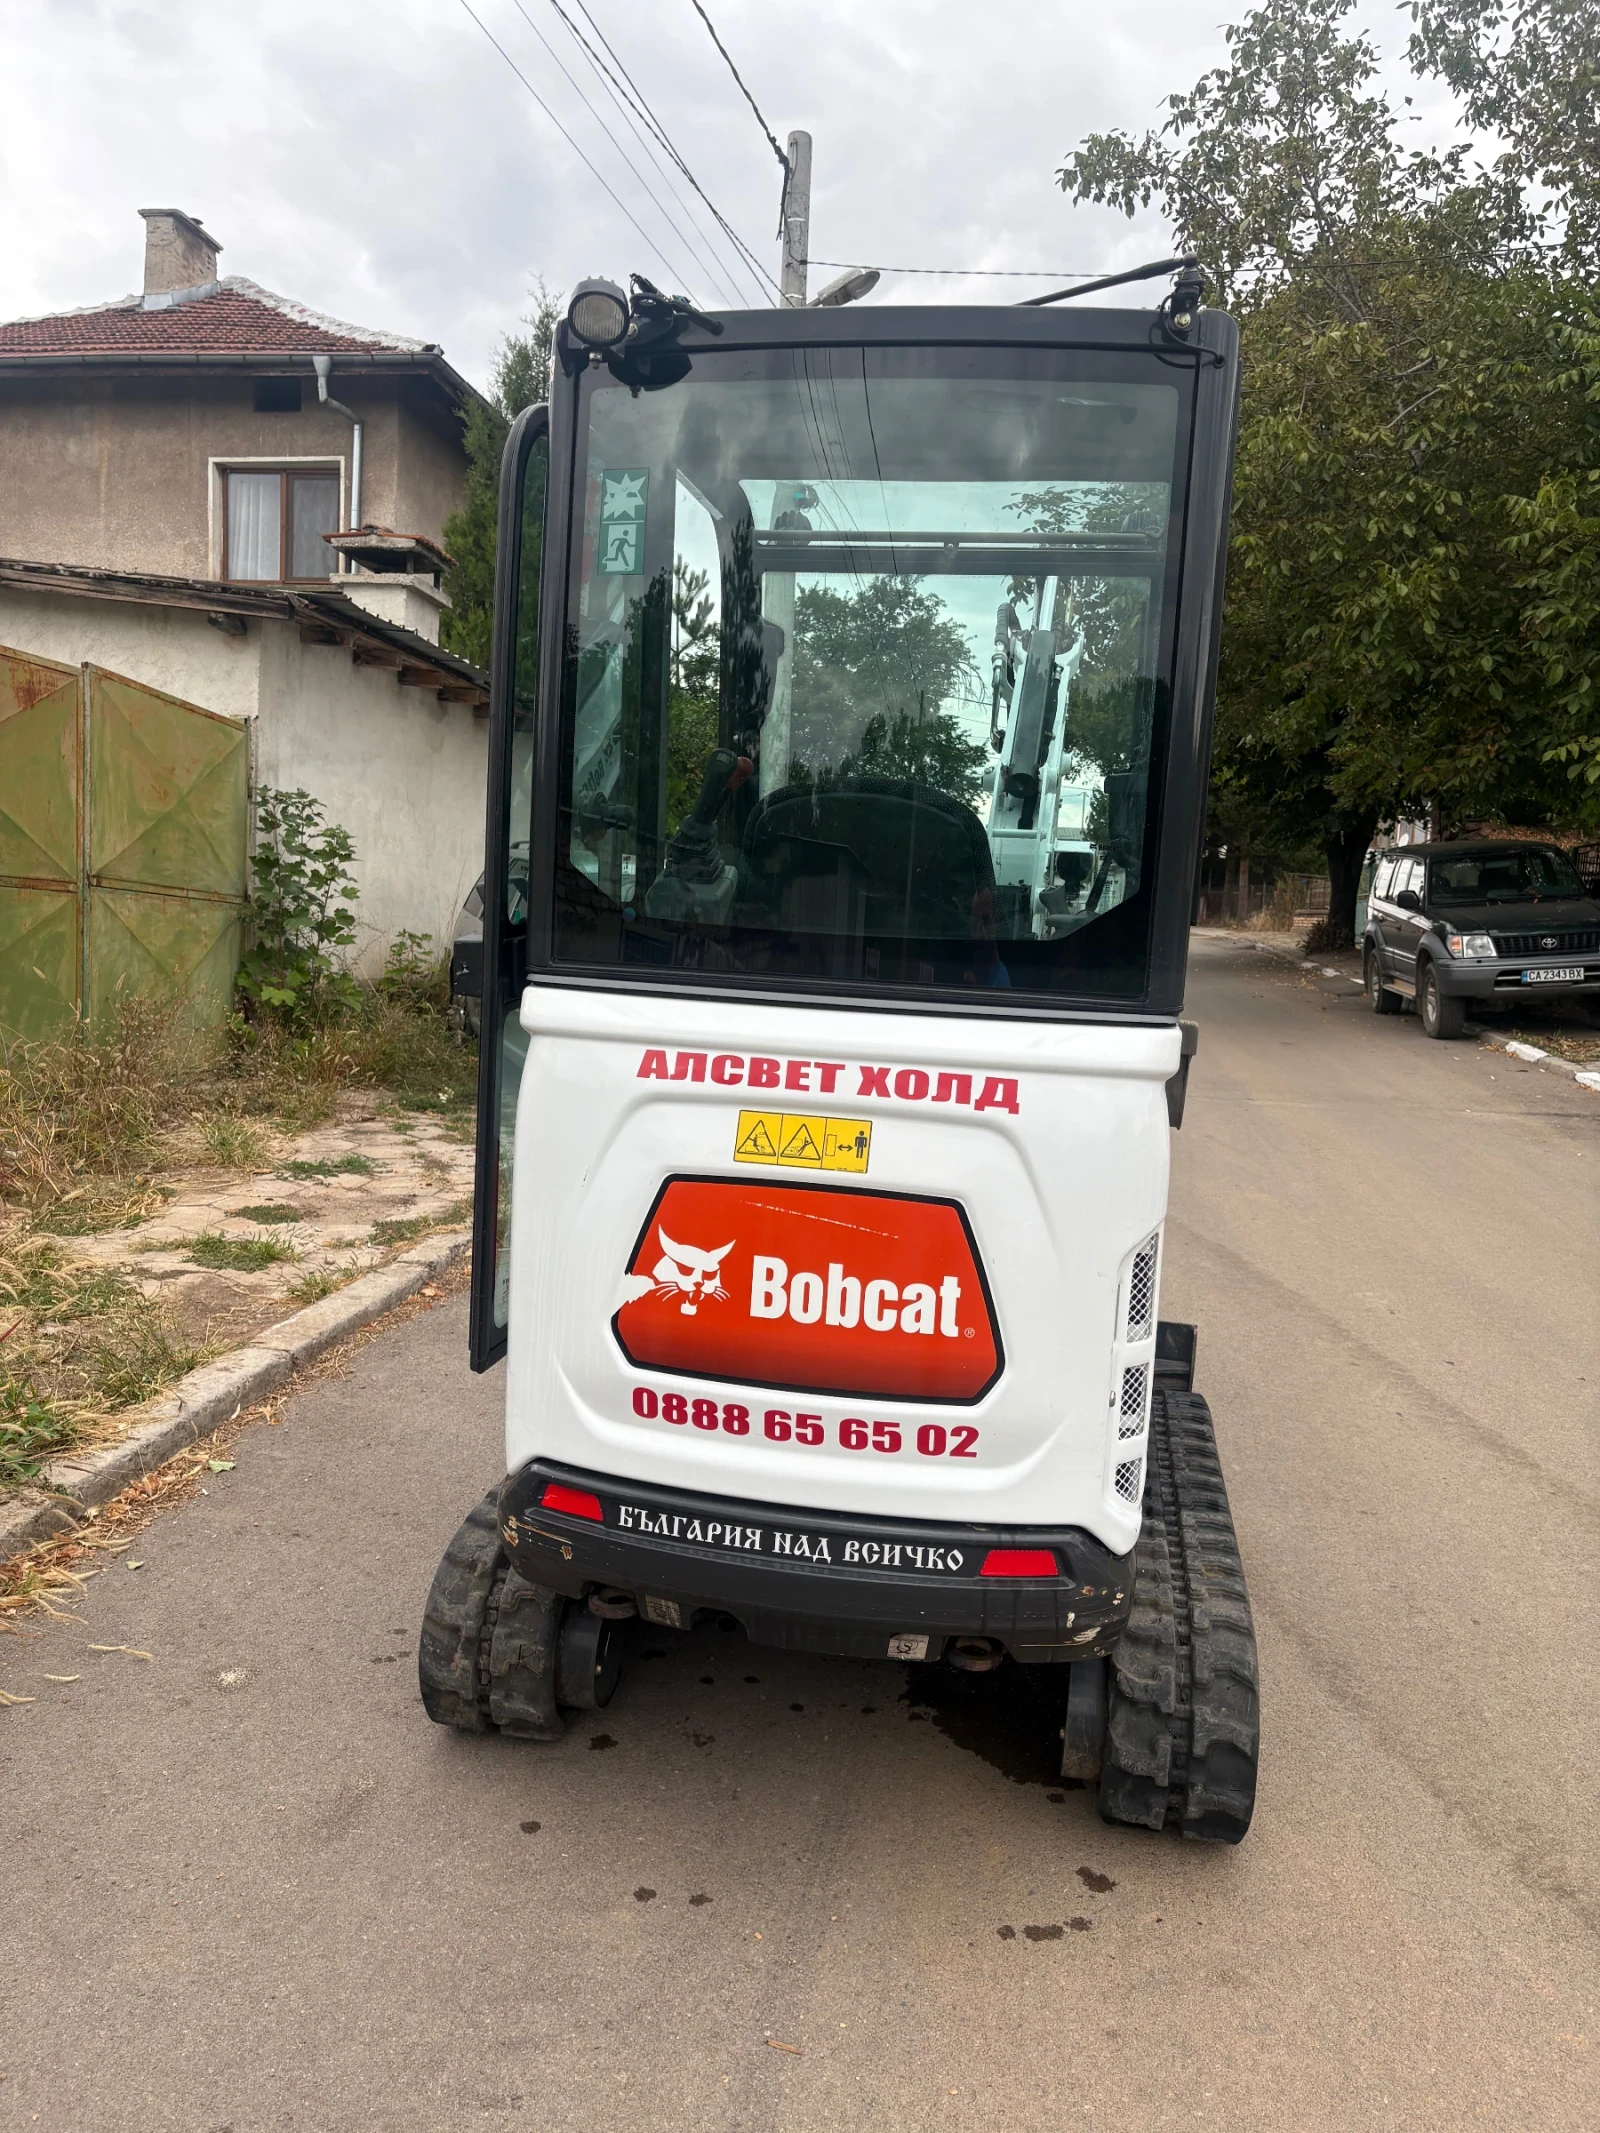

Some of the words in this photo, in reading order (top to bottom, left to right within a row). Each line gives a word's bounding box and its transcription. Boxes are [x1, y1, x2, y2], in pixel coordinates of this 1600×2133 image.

[1543, 969, 1567, 980] 2343
[637, 1050, 845, 1093] АЛСВЕТ
[858, 1066, 1019, 1114] ХОЛД
[750, 1256, 961, 1337] Bobcat
[632, 1387, 749, 1435] 0888
[764, 1410, 824, 1446] 65
[839, 1418, 902, 1453] 65
[917, 1424, 978, 1458] 02
[618, 1505, 762, 1551] БЪЛГАРИЯ
[773, 1532, 832, 1564] НАД
[843, 1540, 965, 1572] ВСИЧКО
